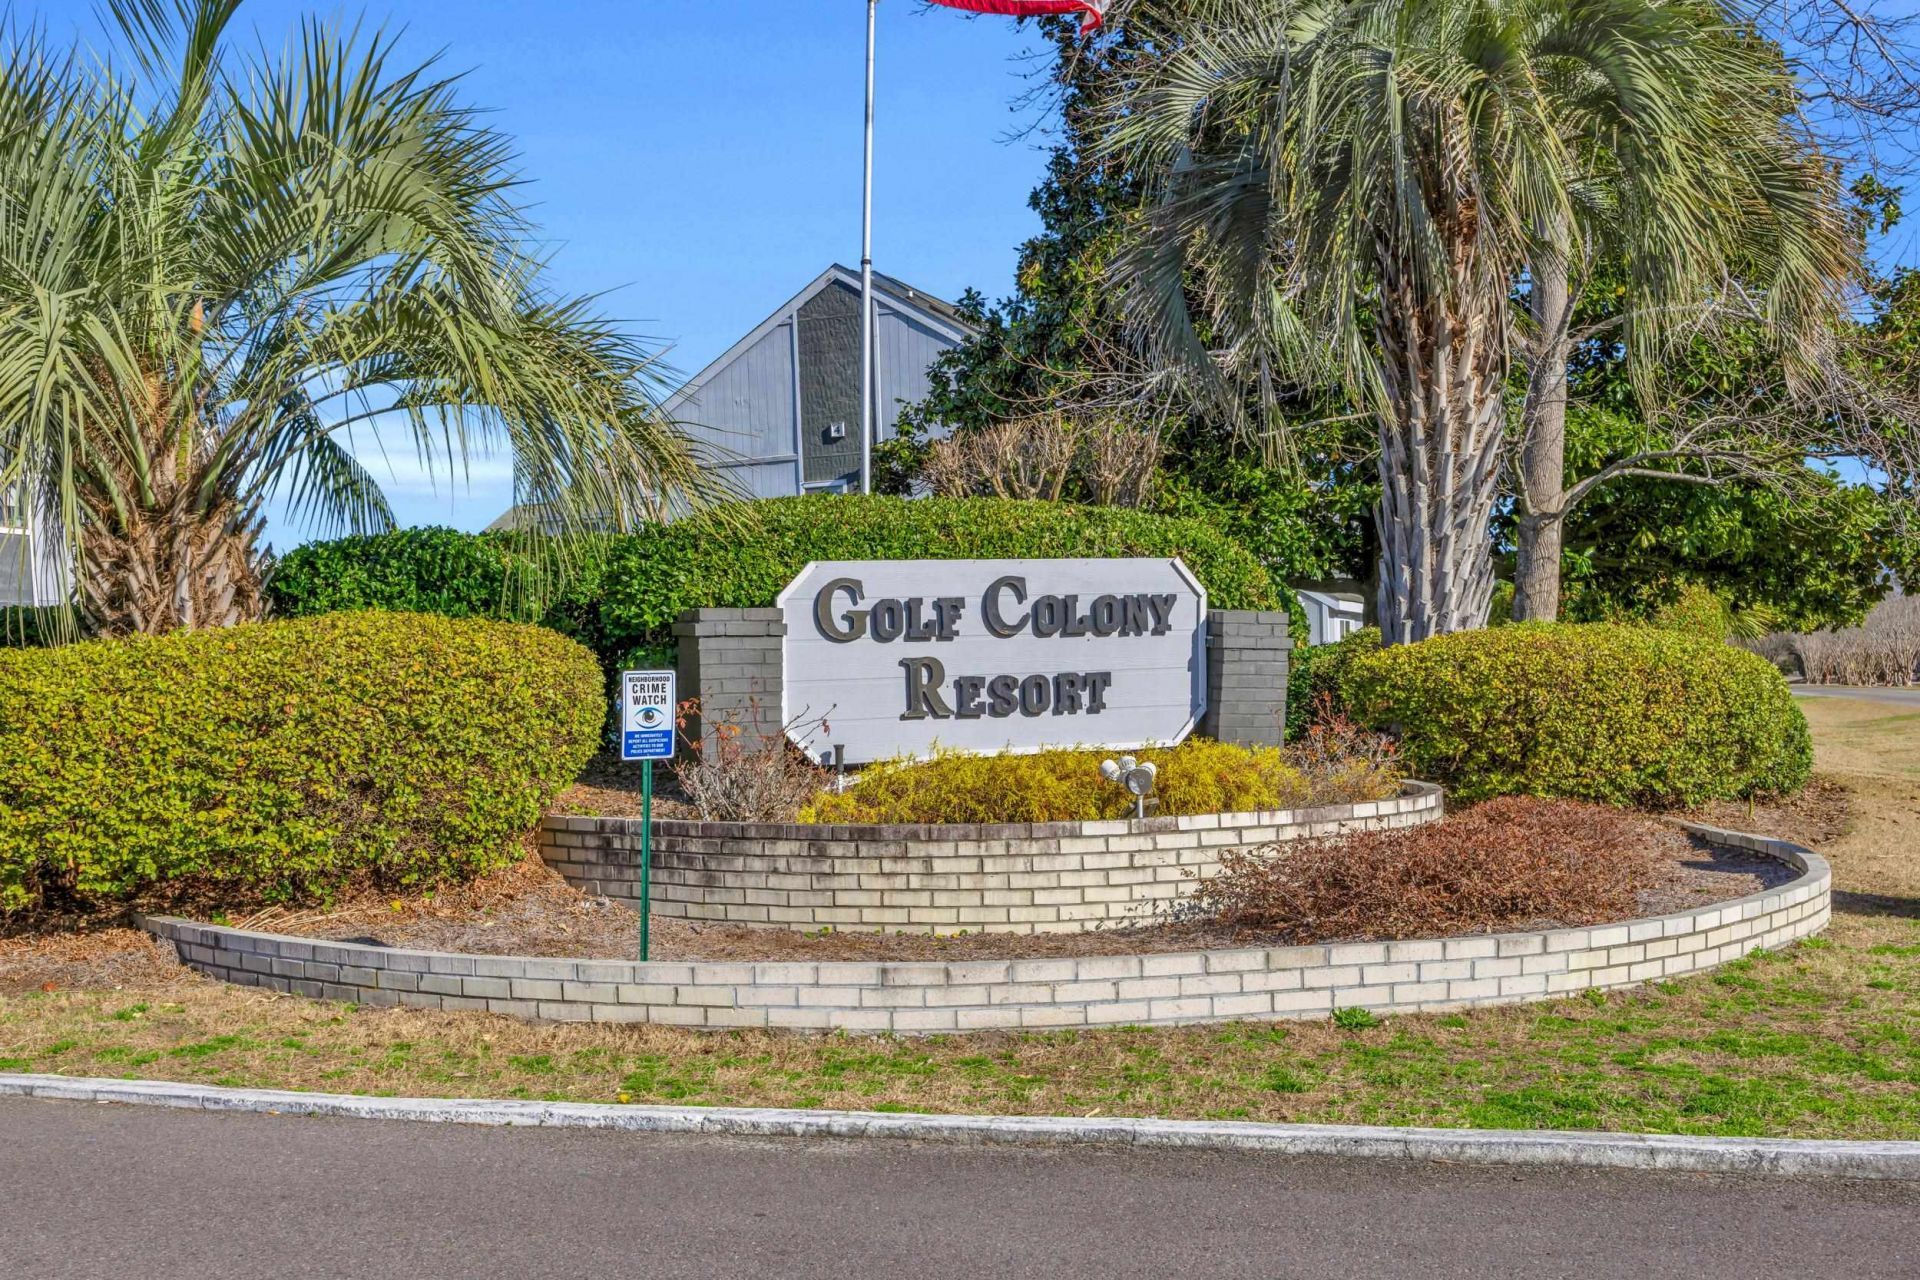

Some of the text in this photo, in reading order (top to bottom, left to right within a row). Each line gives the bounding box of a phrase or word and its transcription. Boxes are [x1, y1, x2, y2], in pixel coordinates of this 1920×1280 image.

[814, 575, 1177, 643] GOLF COLONY
[632, 683, 667, 694] CRIME
[632, 695, 667, 705] WATCH
[898, 656, 1111, 721] RESORT
